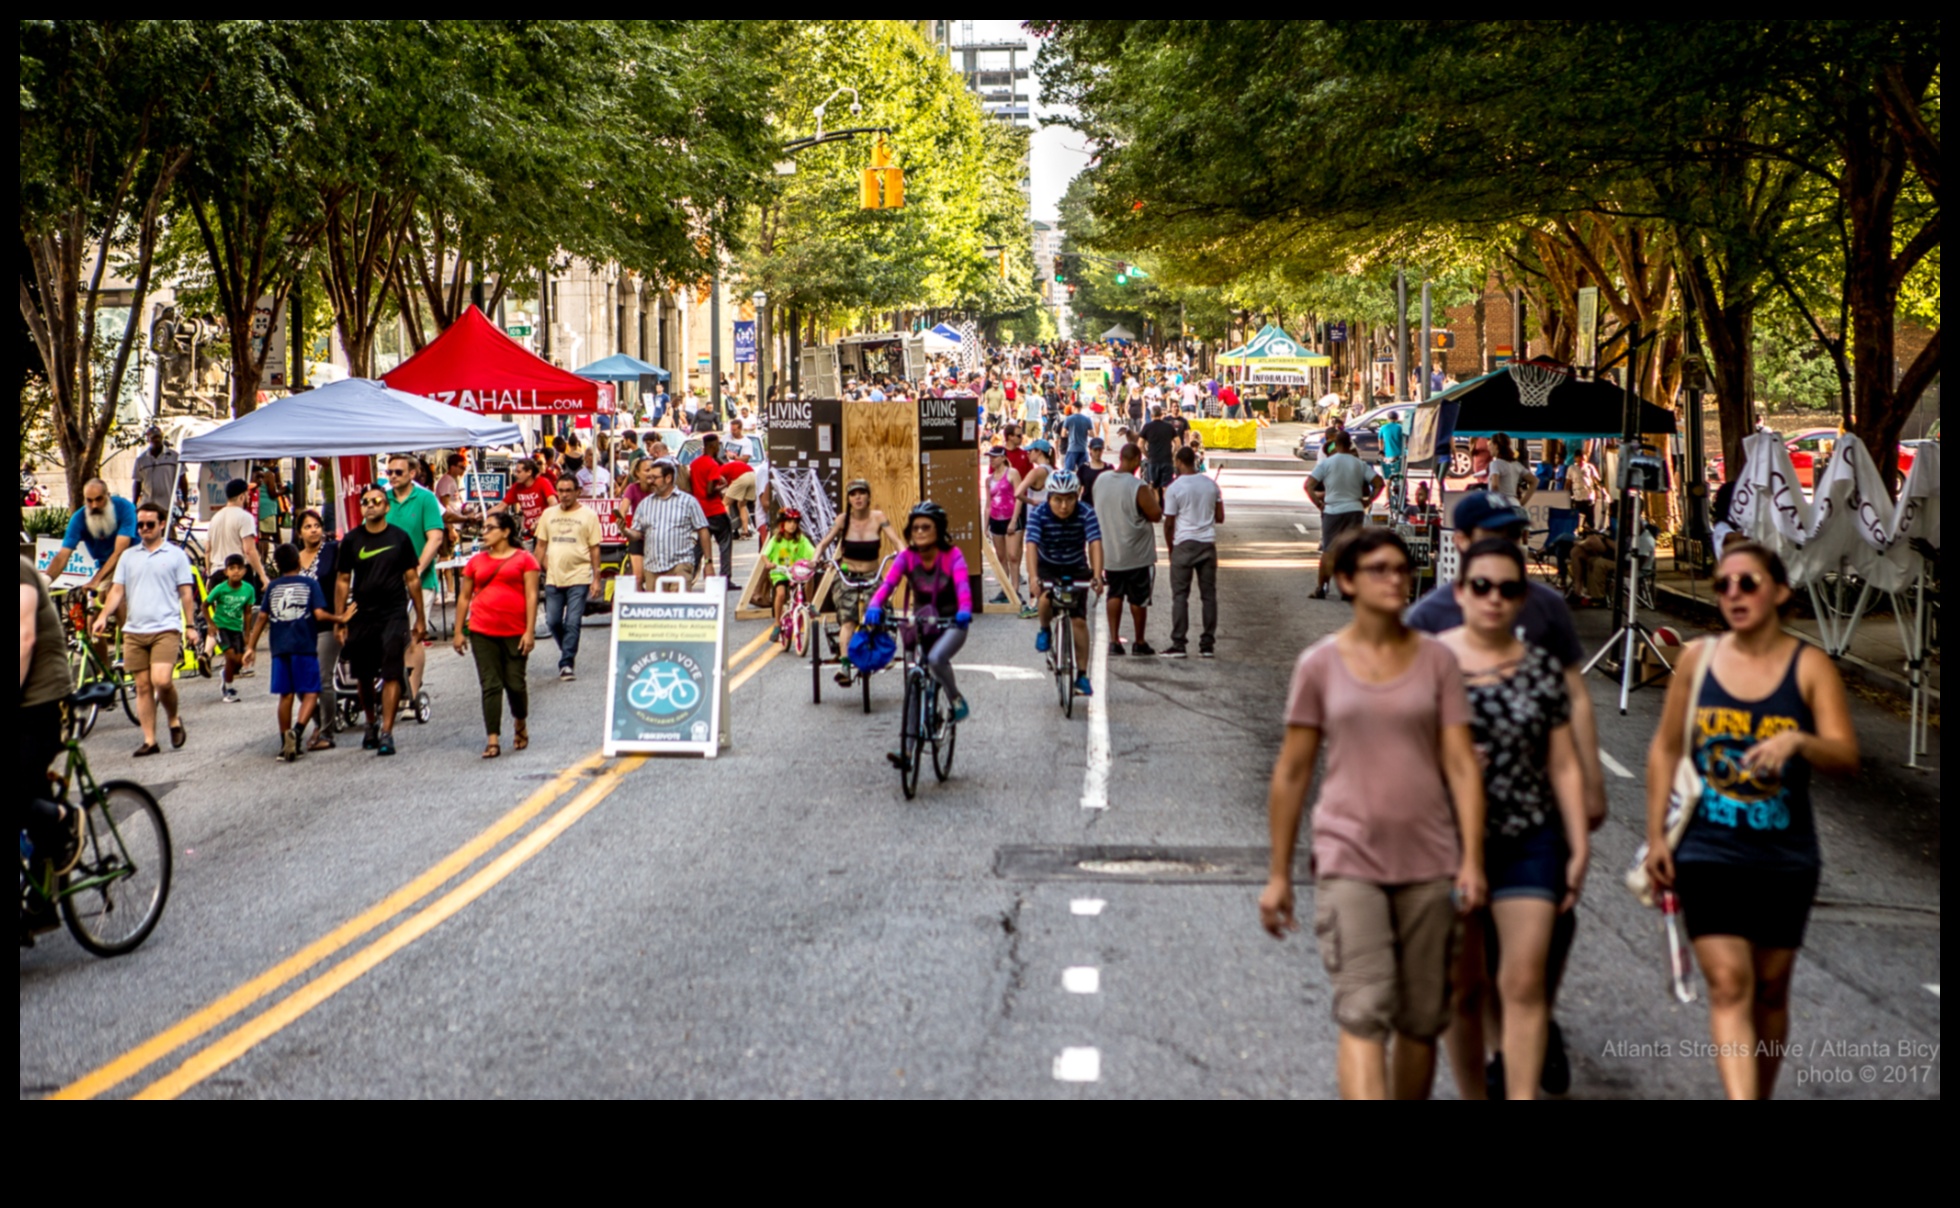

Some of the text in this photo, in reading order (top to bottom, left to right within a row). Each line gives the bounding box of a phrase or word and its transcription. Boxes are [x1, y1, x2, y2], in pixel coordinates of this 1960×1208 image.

[1252, 374, 1306, 383] INFORMATION
[769, 402, 812, 420] LIVING
[921, 400, 956, 418] LIVING
[769, 420, 812, 429] INFOGRAPHIC
[921, 417, 956, 426] INFOGRAPHIC
[621, 606, 716, 618] CANDIDATE ROW
[631, 651, 658, 674] BIKE
[678, 653, 702, 680] VOTE
